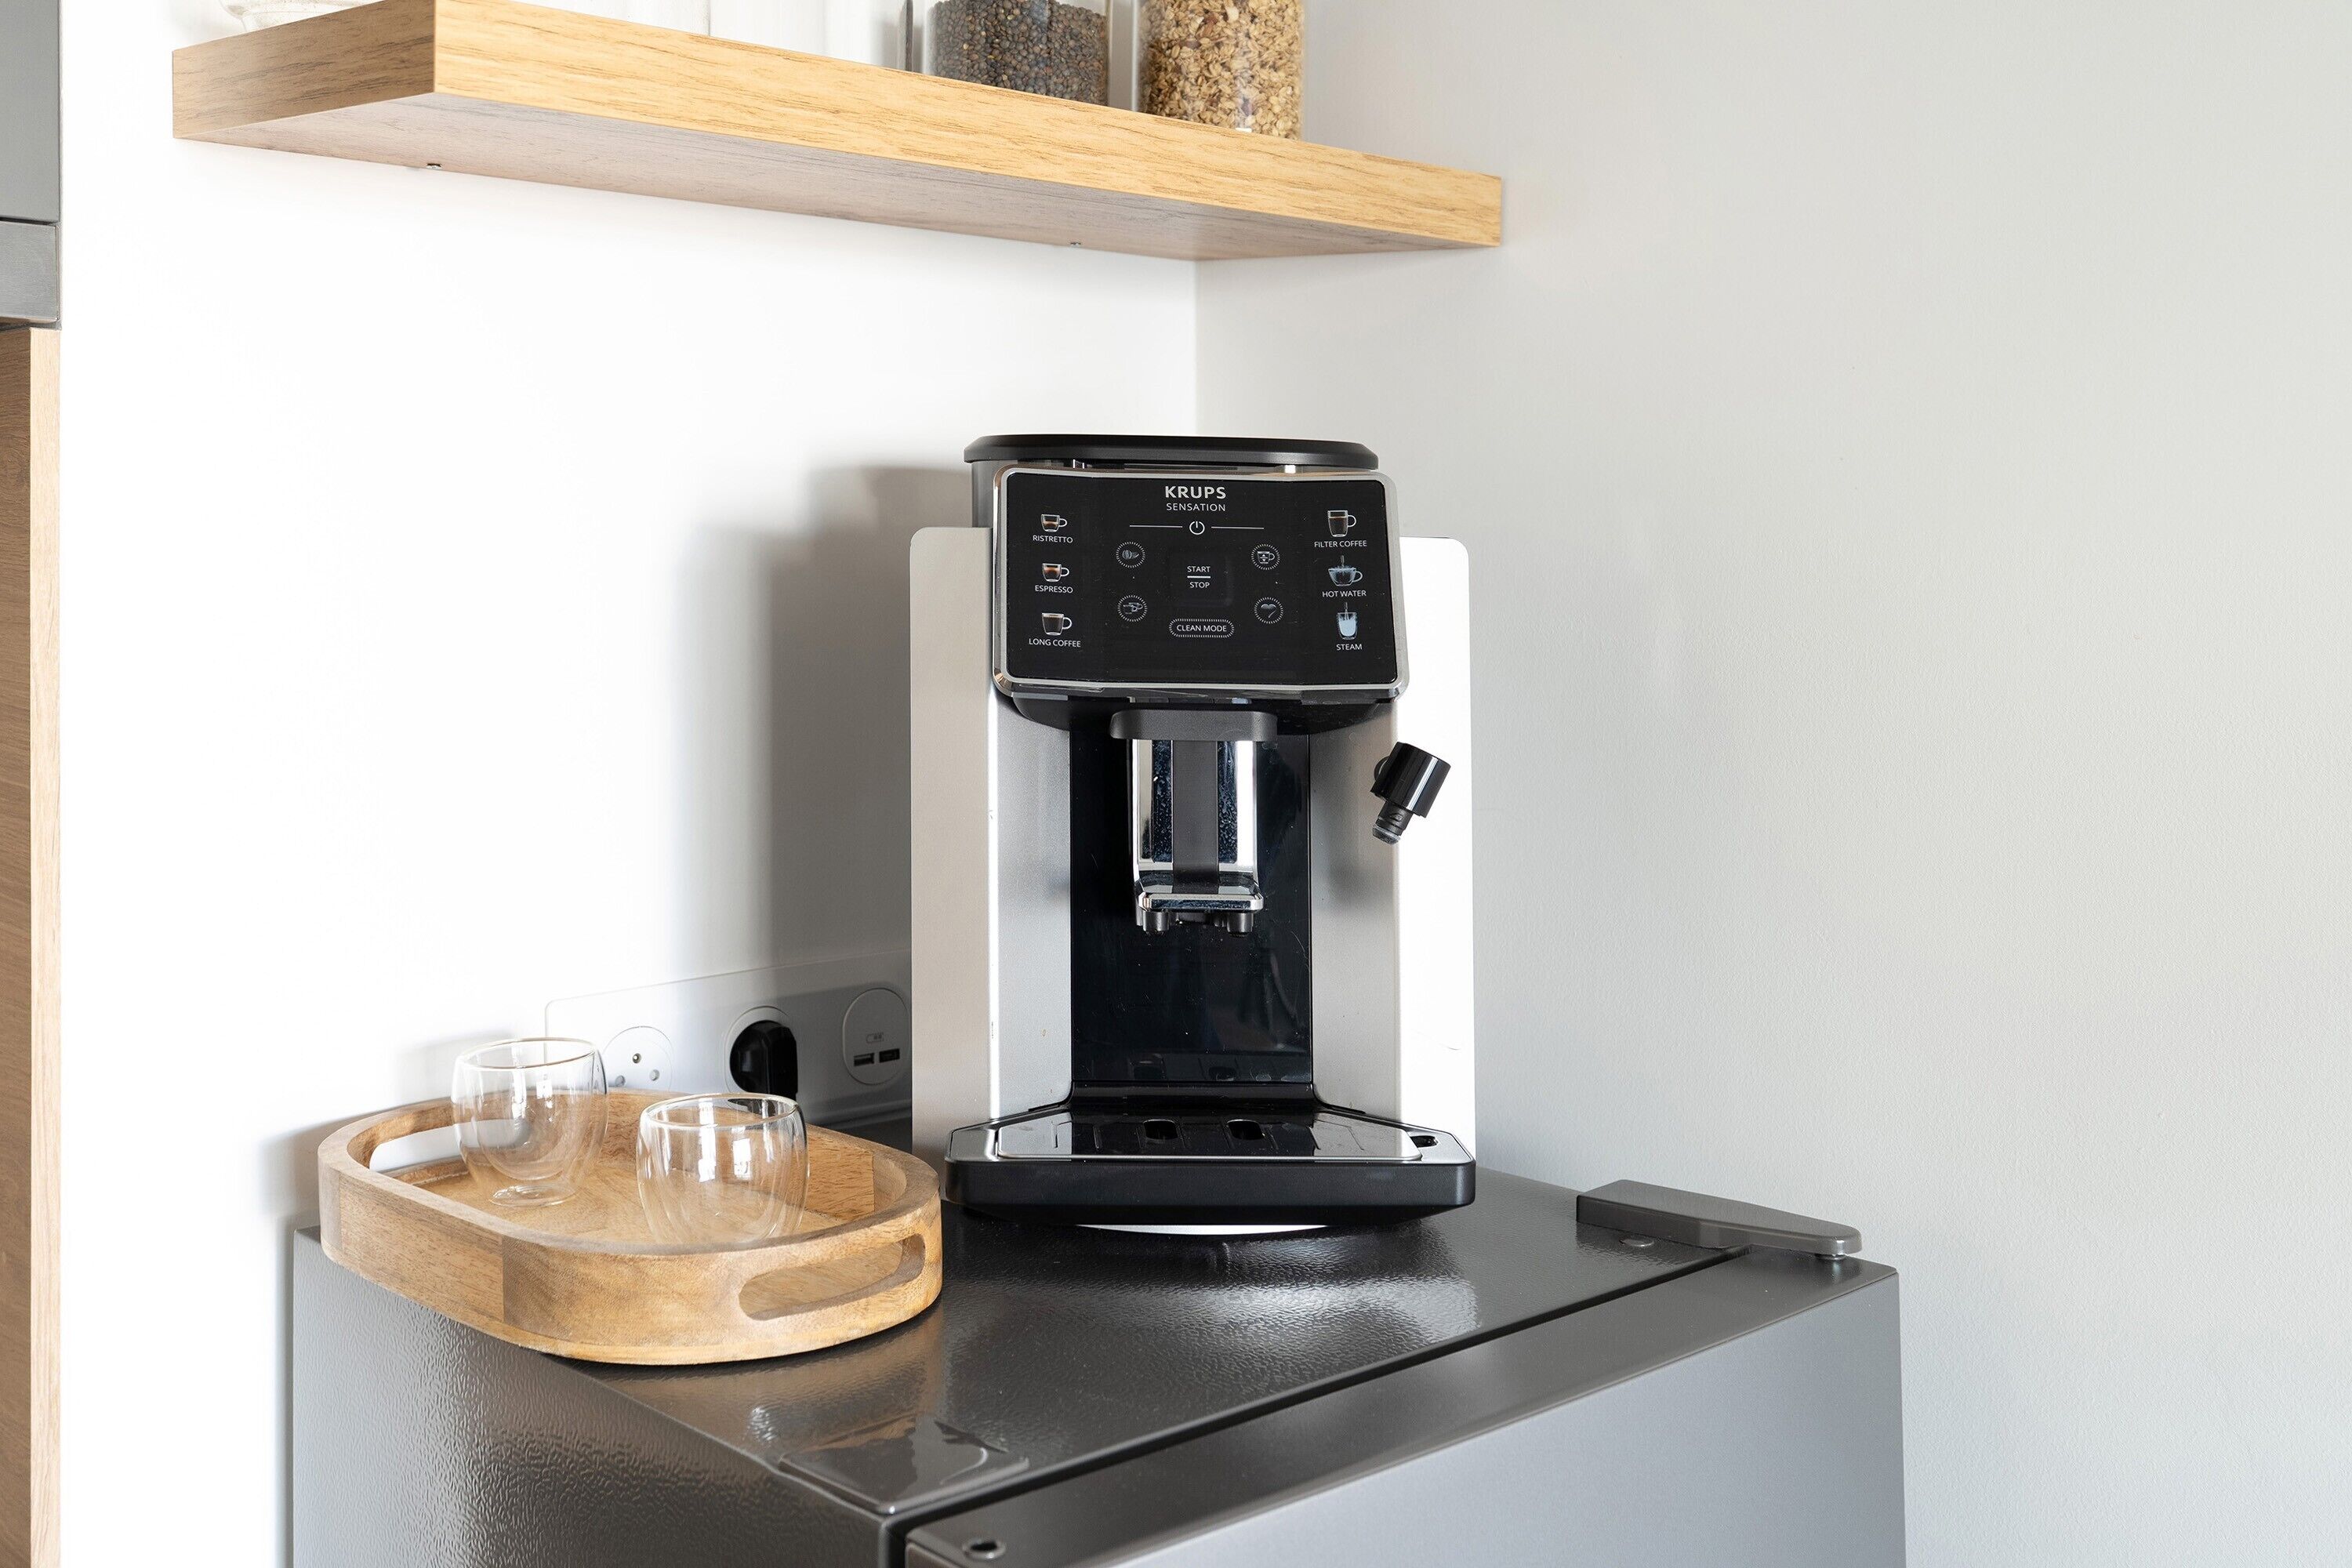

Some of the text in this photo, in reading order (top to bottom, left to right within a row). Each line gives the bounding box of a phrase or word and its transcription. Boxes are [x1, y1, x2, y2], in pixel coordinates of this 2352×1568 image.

[1164, 485, 1226, 499] KRUPS
[1166, 503, 1226, 512] SENSATION
[1032, 534, 1073, 543] RISTRETTO
[1338, 539, 1367, 548] COFFEE
[1034, 584, 1074, 593] ESPRESSO
[1203, 624, 1227, 633] MODE
[1029, 637, 1081, 648] LONG COFFEE
